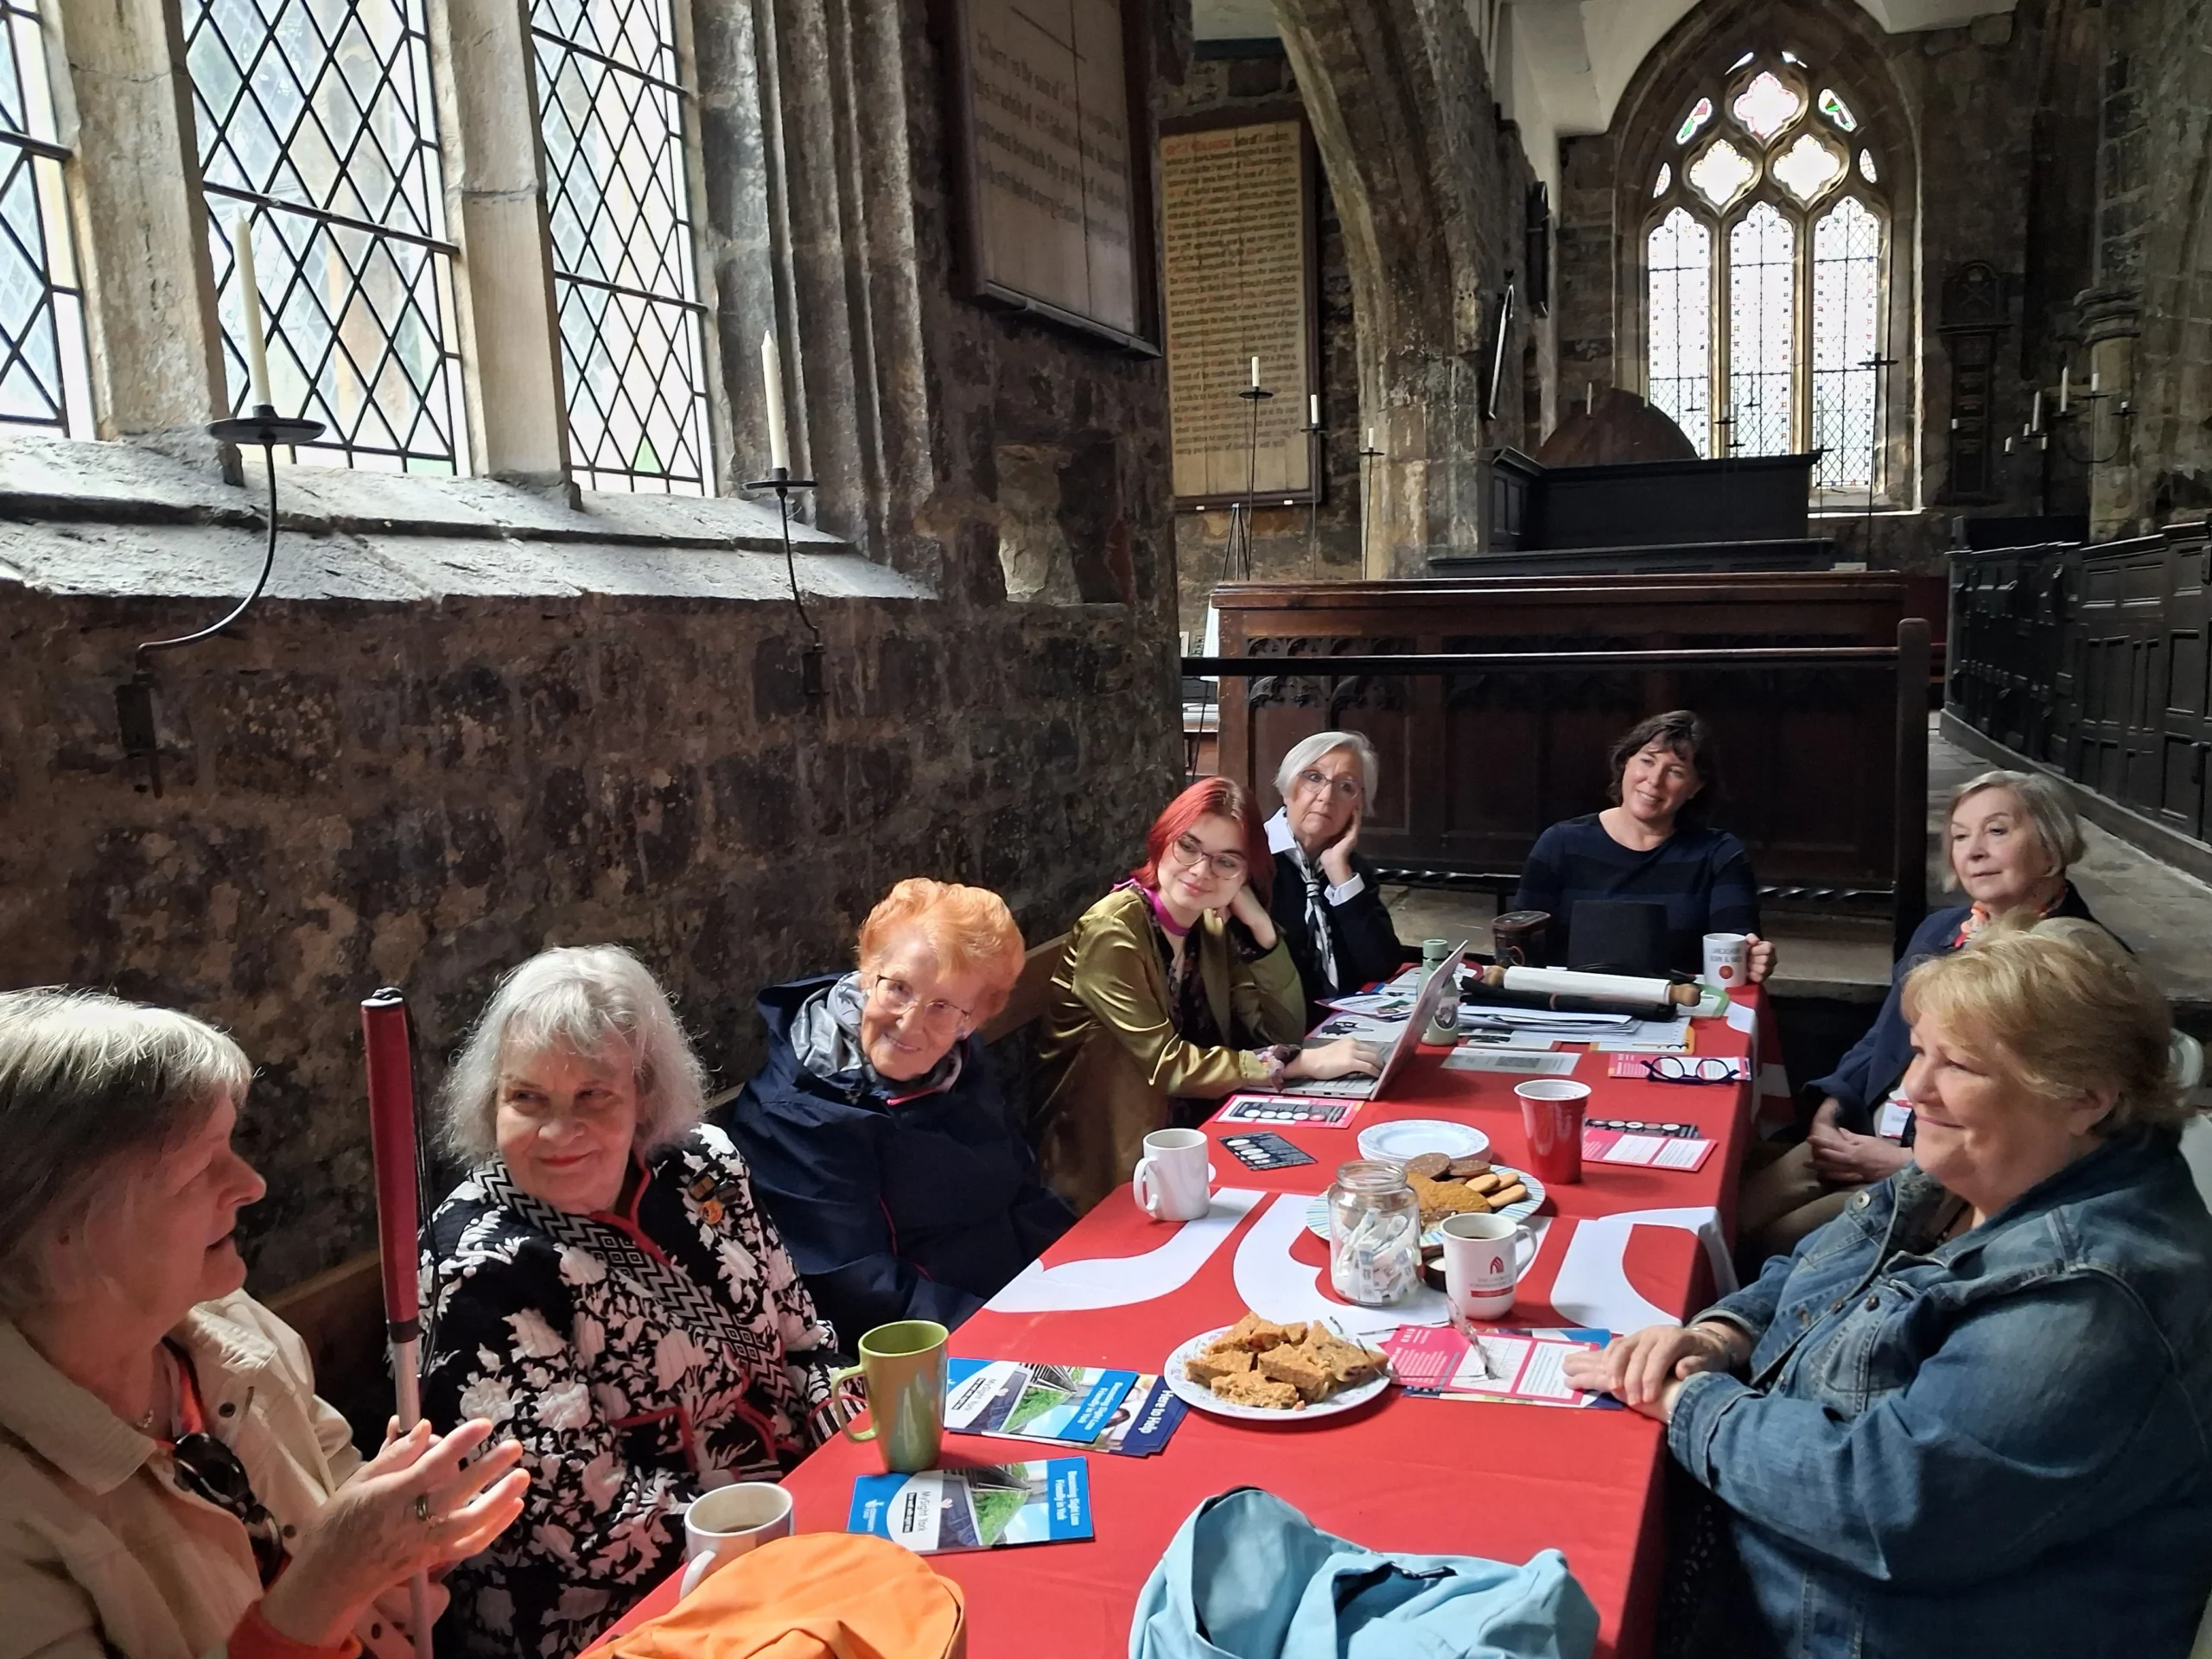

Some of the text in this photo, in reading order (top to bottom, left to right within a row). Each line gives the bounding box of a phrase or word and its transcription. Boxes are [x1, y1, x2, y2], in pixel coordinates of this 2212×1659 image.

[1088, 1387, 1109, 1408] Friendly
[1077, 1413, 1092, 1424] York
[1092, 1407, 1108, 1420] Sight
[1138, 1389, 1174, 1434] Here to Help
[1084, 1419, 1099, 1430] Loss
[1053, 1478, 1066, 1501] Friendly
[918, 1491, 931, 1532] MySight York
[1068, 1498, 1080, 1513] Sight
[1057, 1508, 1067, 1521] York
[1071, 1513, 1080, 1526] Loss
